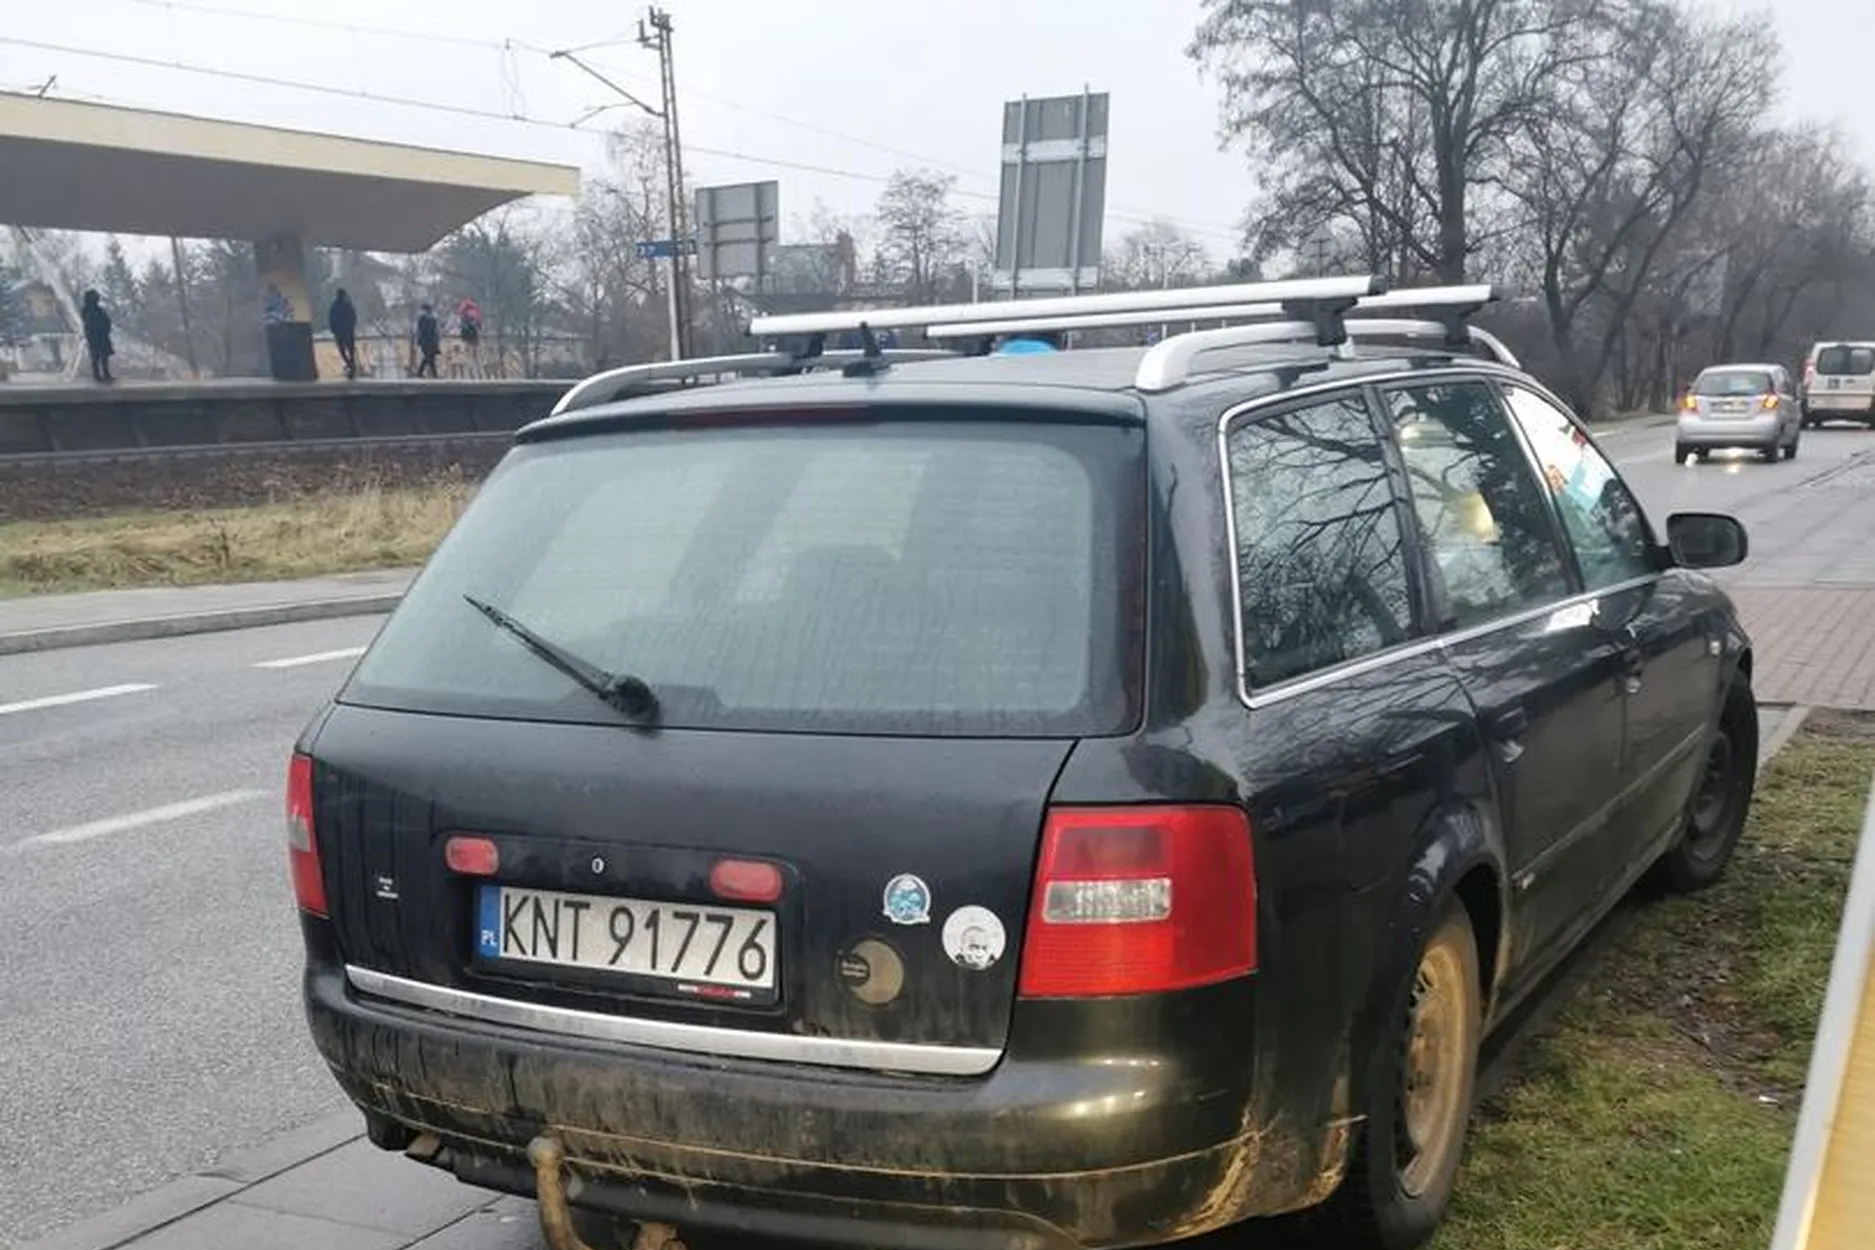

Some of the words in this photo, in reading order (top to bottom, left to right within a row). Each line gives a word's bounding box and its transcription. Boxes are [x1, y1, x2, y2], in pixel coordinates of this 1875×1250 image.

[481, 930, 498, 946] PL
[503, 894, 591, 961] KNT
[608, 904, 767, 981] 91776
